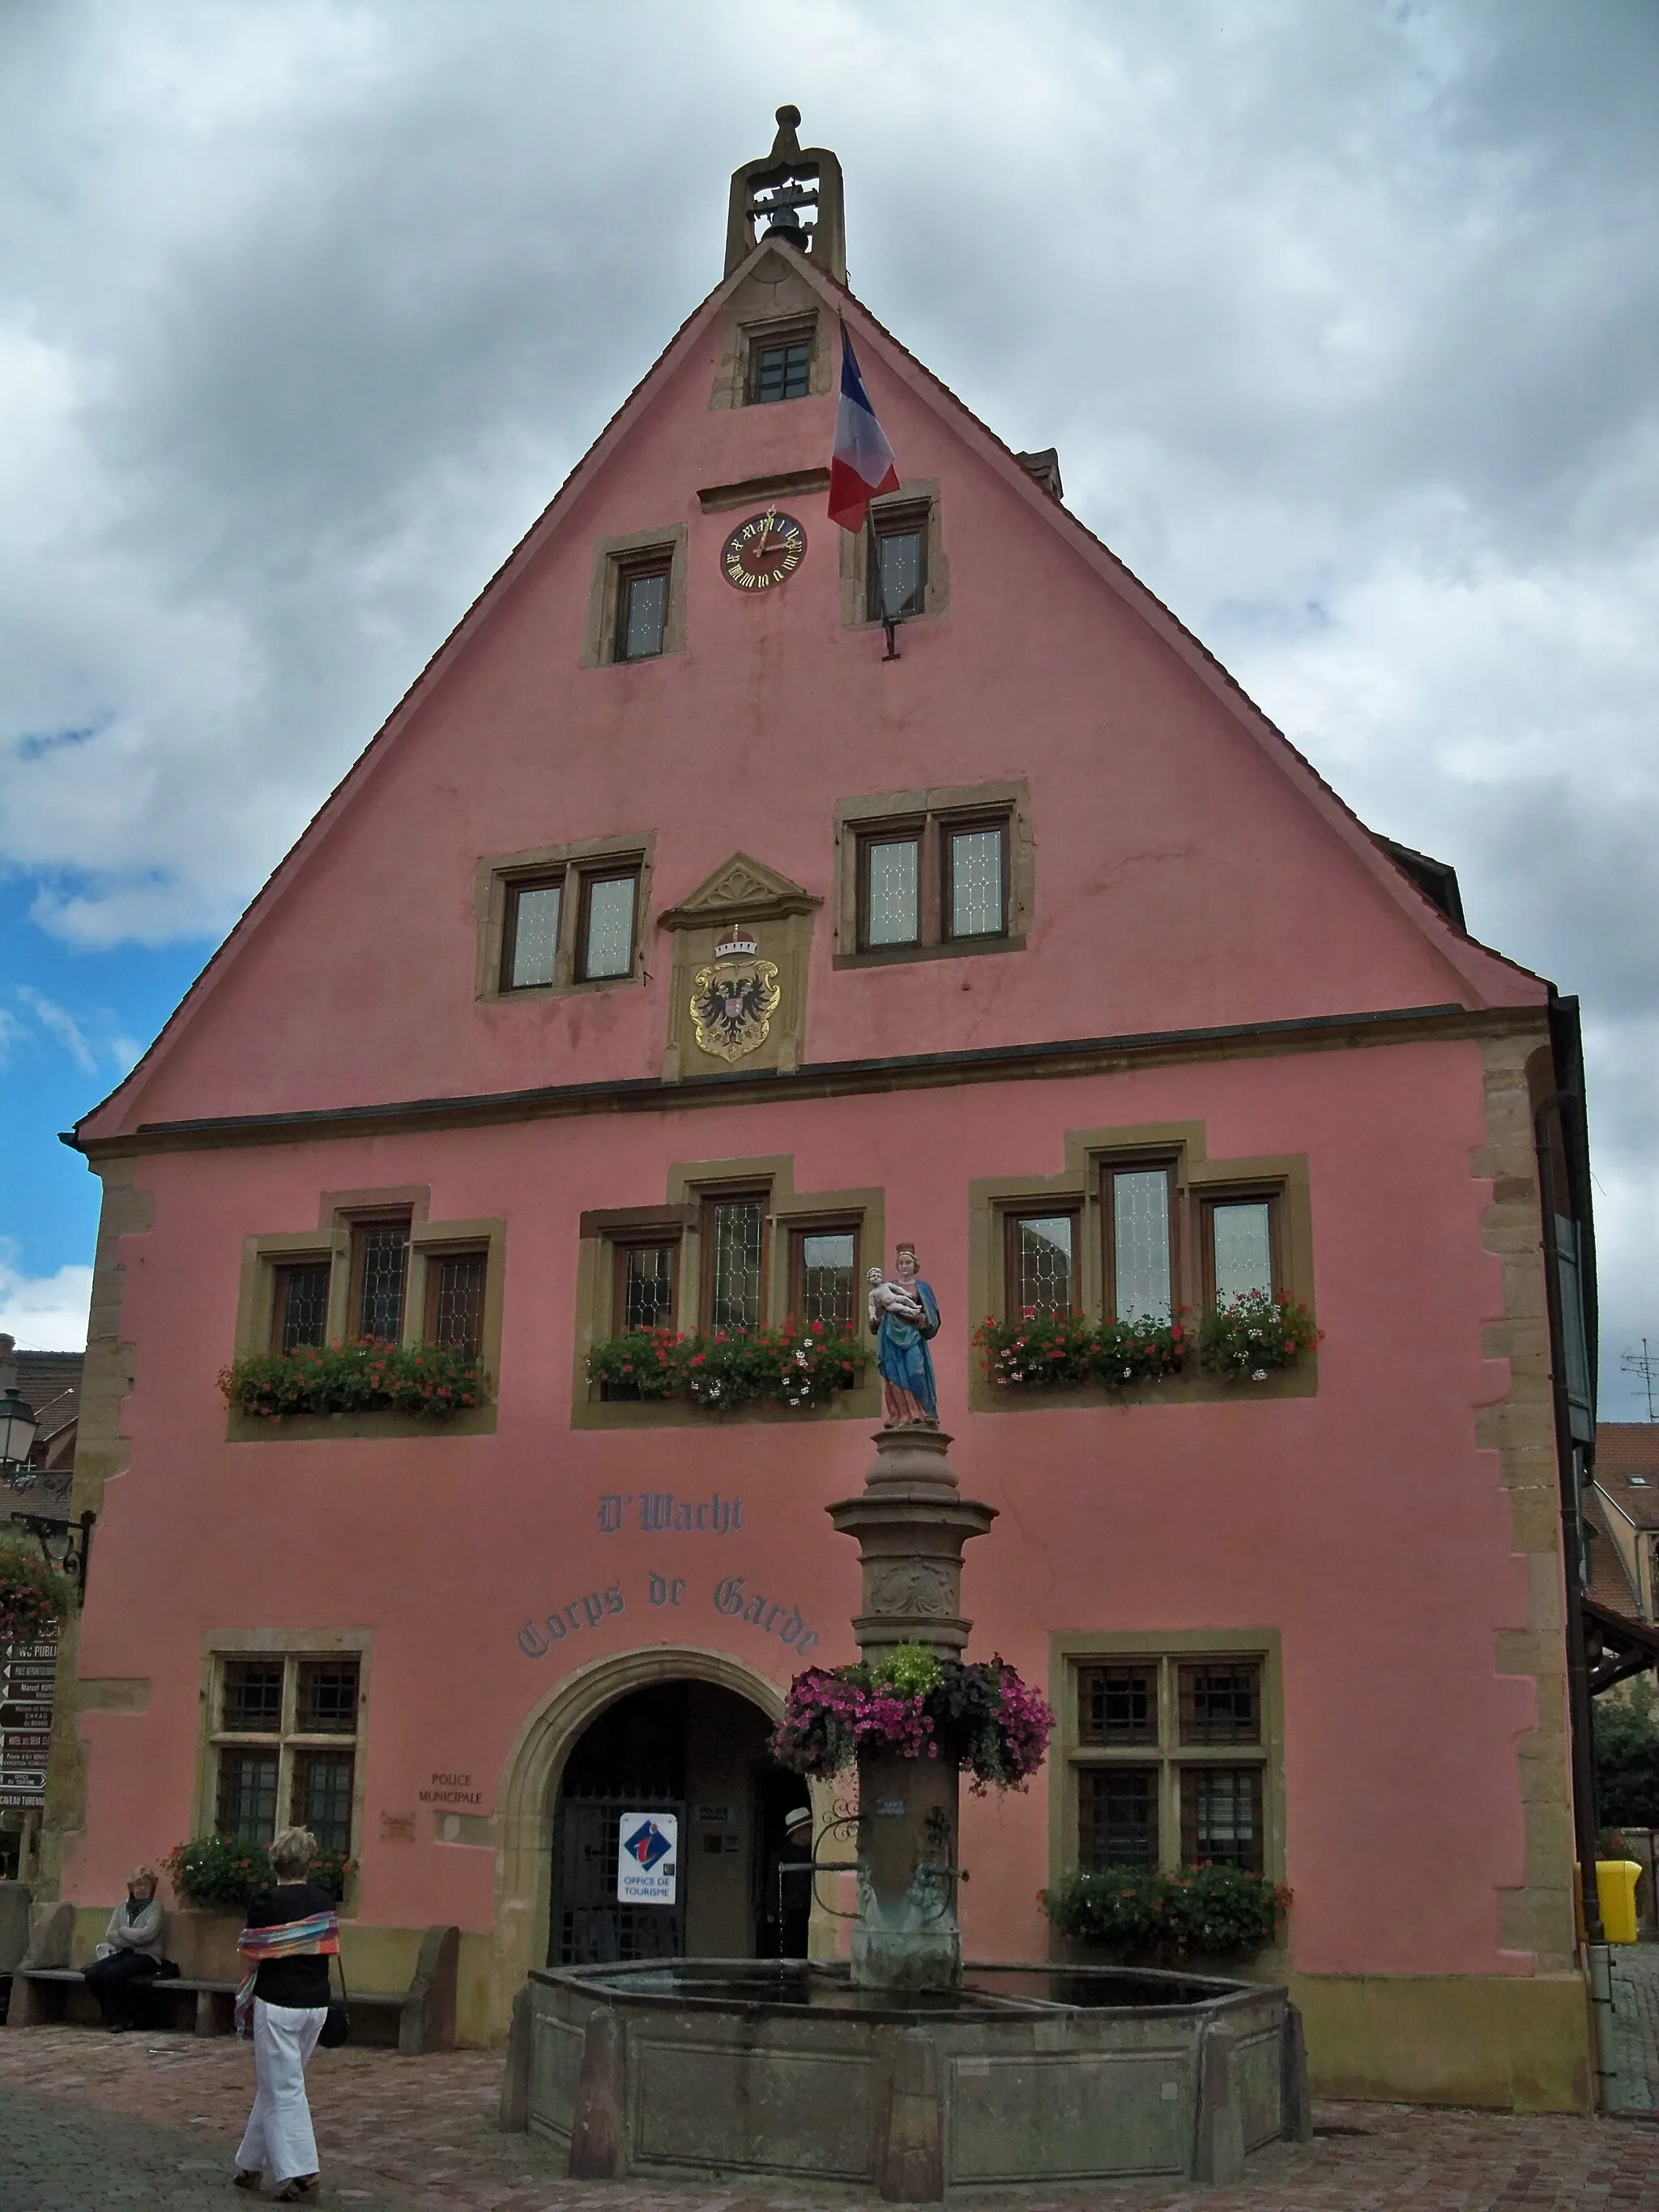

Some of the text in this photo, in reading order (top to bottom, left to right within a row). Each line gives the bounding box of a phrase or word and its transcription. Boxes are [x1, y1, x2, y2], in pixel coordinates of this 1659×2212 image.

[517, 1571, 820, 1659] Corps de Garde
[432, 1774, 471, 1786] POLICE
[420, 1791, 483, 1804] MUNICIPALE
[624, 1877, 670, 1886] OFFICE DE
[625, 1886, 669, 1897] TOURISME
